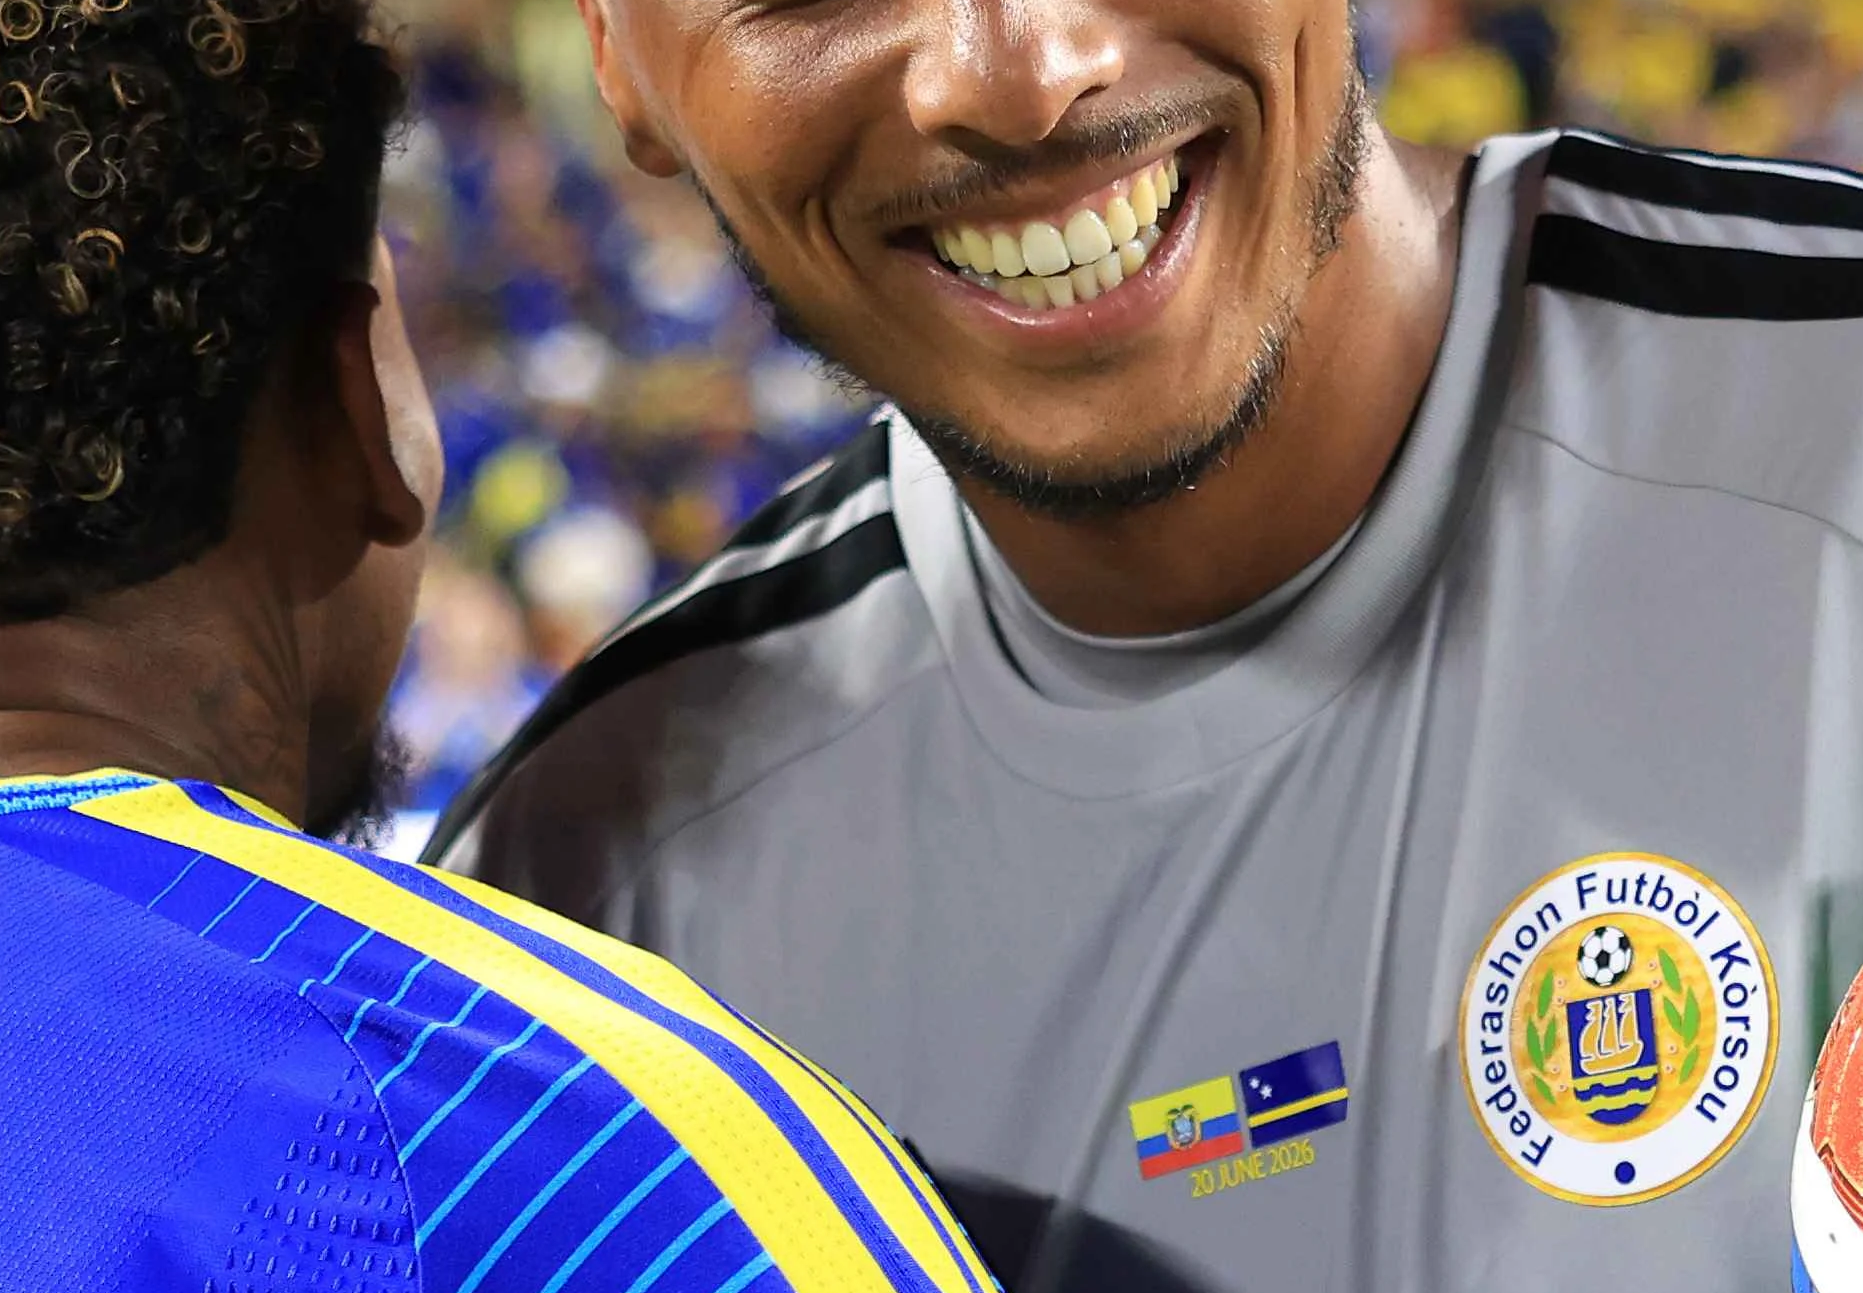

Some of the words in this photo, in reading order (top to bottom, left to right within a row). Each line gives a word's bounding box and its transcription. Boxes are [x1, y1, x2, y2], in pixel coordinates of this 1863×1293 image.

[1480, 901, 1562, 1167] Federashon
[1575, 872, 1720, 939] Futbòl
[1695, 940, 1758, 1123] Kòrsou
[1191, 1168, 1215, 1198] 20
[1218, 1152, 1267, 1191] JUNE
[1268, 1138, 1315, 1175] 2026
